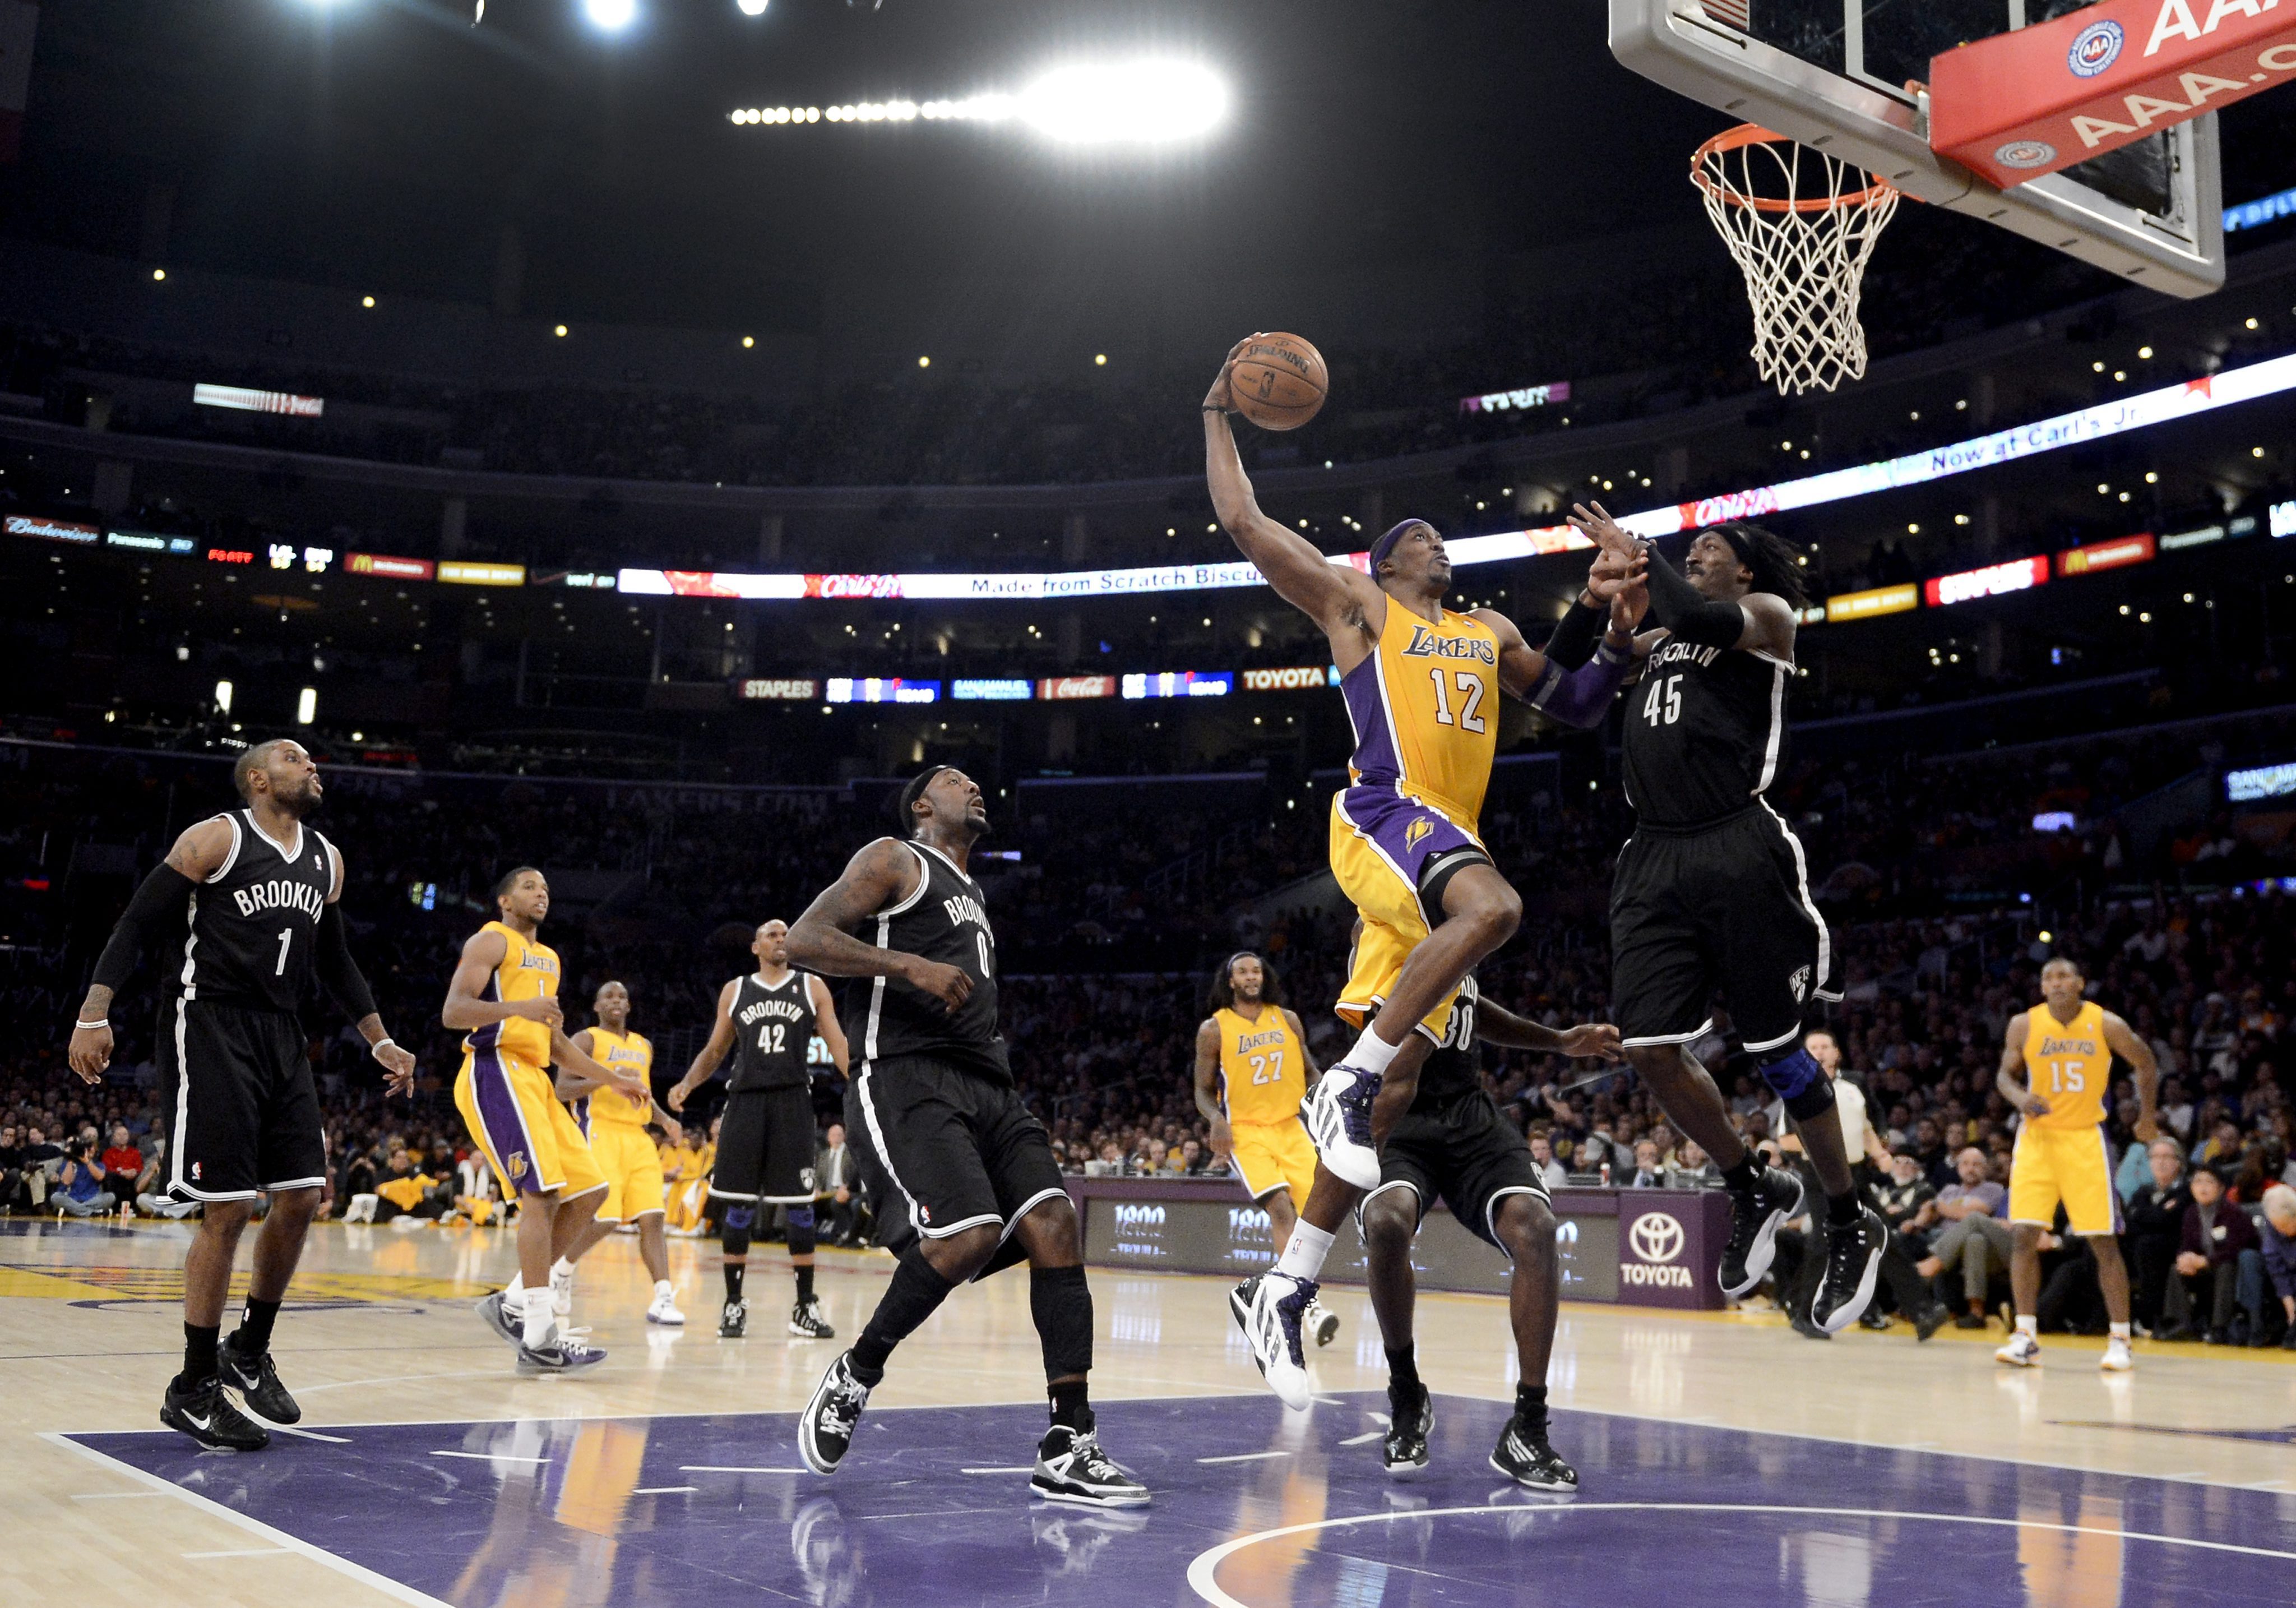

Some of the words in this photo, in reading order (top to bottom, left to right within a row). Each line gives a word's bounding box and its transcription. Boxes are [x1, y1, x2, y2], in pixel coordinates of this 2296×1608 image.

[2144, 0, 2280, 57] AA
[2083, 37, 2108, 57] AAA
[1932, 447, 1984, 471] Now
[1994, 436, 2016, 455] at
[2028, 415, 2101, 446] Carl's
[6, 516, 98, 542] Budweiser
[973, 579, 1032, 593] Made
[1043, 577, 1090, 593] from
[1100, 567, 1185, 589] Scratch
[1196, 562, 1265, 584] Biscu
[1402, 624, 1495, 666] LAKERS
[1647, 642, 1721, 673] ROOKLYN
[745, 680, 814, 699] STAPLES
[1243, 668, 1325, 689] TOYOTA
[1429, 667, 1485, 734] 12
[1643, 674, 1683, 727] 45
[233, 880, 324, 925] BROOKLYN
[276, 928, 292, 976] 1
[976, 931, 990, 978] 0
[740, 1000, 804, 1025] BROOKLYN
[1441, 1005, 1473, 1051] 30
[758, 1024, 785, 1054] 42
[1235, 1029, 1285, 1057] LAKERS
[1249, 1050, 1284, 1086] 27
[2050, 1061, 2085, 1093] 15
[1620, 1263, 1693, 1287] TOYOTA
